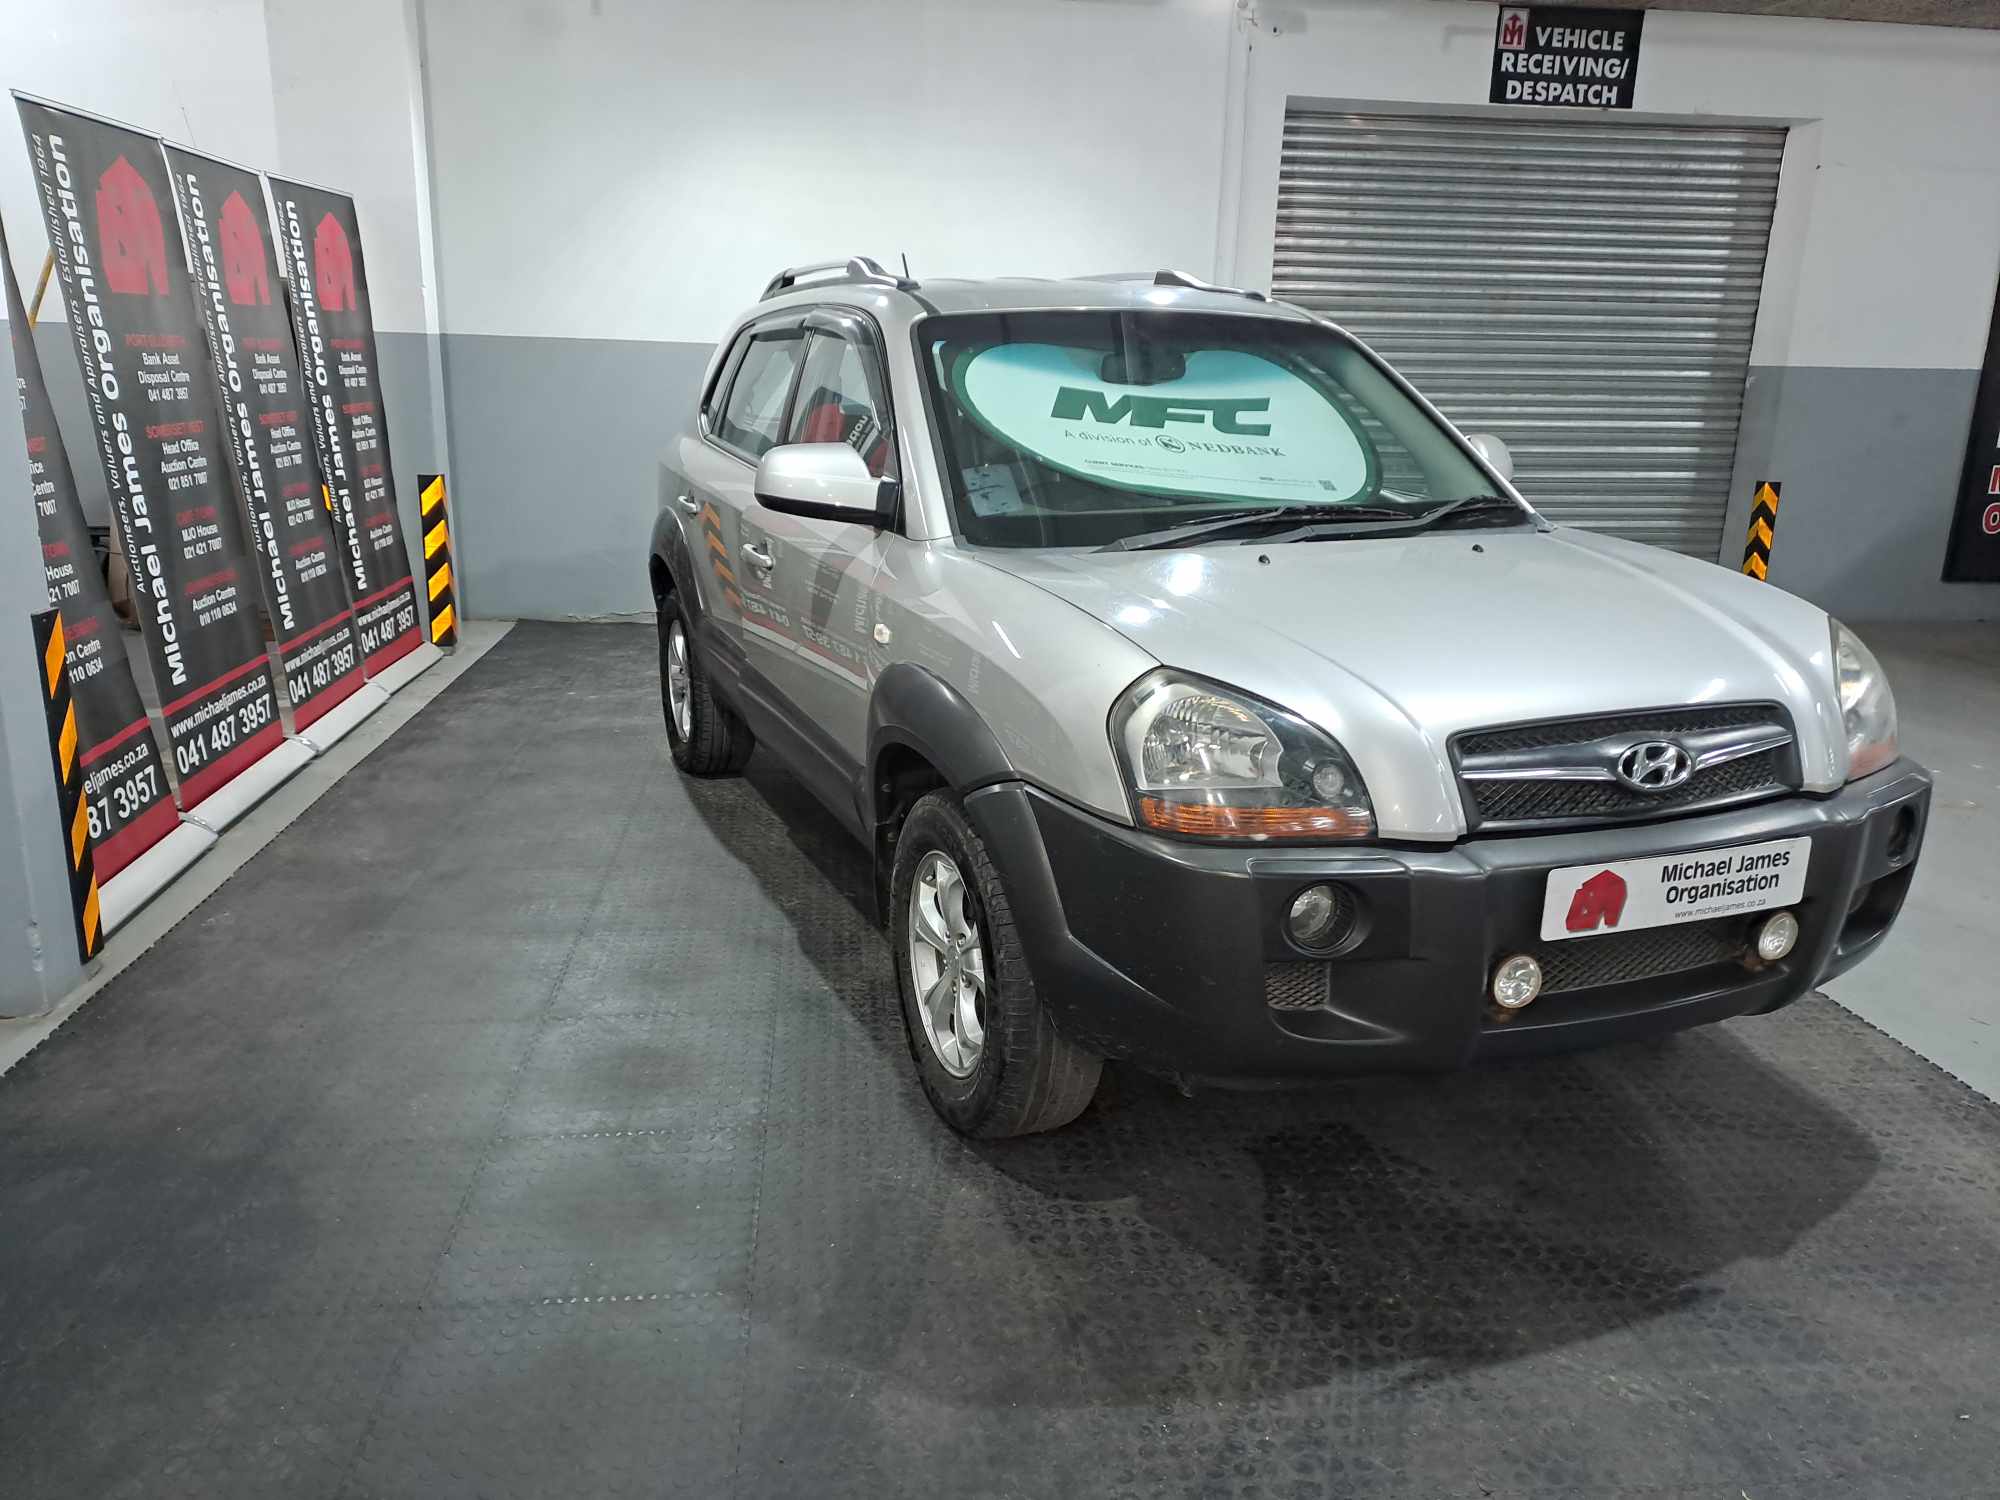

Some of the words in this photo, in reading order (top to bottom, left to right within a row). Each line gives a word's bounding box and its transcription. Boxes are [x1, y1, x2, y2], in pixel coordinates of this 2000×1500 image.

[1536, 26, 1625, 51] VEHICLE
[1500, 52, 1630, 80] RECEIVING/
[1505, 80, 1618, 105] DESPATCH
[32, 133, 49, 177] 1964
[42, 185, 72, 282] Established
[49, 134, 120, 401] Organisation
[186, 174, 241, 392] Organisation
[286, 200, 328, 387] Organisation
[70, 299, 98, 389] Appraisers
[142, 352, 161, 365] Bank
[138, 370, 170, 386] Disposal
[148, 389, 161, 402] 041
[161, 388, 174, 400] 487
[306, 381, 318, 404] and
[91, 393, 106, 425] and
[313, 406, 327, 449] Valuers
[1050, 386, 1272, 437] MFC
[236, 402, 267, 503] James
[322, 394, 347, 481] James
[1064, 430, 1075, 439] A
[1078, 431, 1136, 445] division
[1138, 436, 1152, 446] of
[1189, 441, 1287, 457] NEDBANK
[101, 430, 121, 489] Valuers
[112, 412, 152, 534] James
[161, 459, 187, 473] Auction
[37, 499, 57, 516] 7007
[117, 497, 146, 593] Auctioneers,
[196, 524, 218, 537] House
[196, 542, 207, 555] 421
[338, 488, 367, 590] Michael
[45, 563, 74, 581] House
[48, 585, 61, 603] 21
[61, 580, 80, 598] 7007
[258, 512, 295, 631] Michael
[140, 545, 187, 686] Michael
[193, 594, 216, 612] Auction
[76, 638, 101, 658] Centre
[361, 626, 381, 654] 041
[380, 617, 396, 642] 487
[397, 605, 415, 632] 3957
[69, 668, 85, 685] 110
[85, 657, 104, 677] 0634
[289, 672, 312, 703] 041
[312, 658, 332, 688] 487
[331, 643, 355, 676] 3957
[170, 674, 266, 738] www.michaeljames.co.za
[176, 733, 208, 774] 041
[211, 714, 236, 751] 487
[239, 693, 271, 733] 3957
[83, 742, 149, 796] eljames.co.za
[87, 796, 112, 839] 87
[113, 764, 158, 819] 3957
[1661, 858, 1732, 883] Michael
[1736, 850, 1791, 873] James
[1666, 873, 1780, 905] Organisation
[1674, 898, 1767, 919] www.michaeljames.co.za
